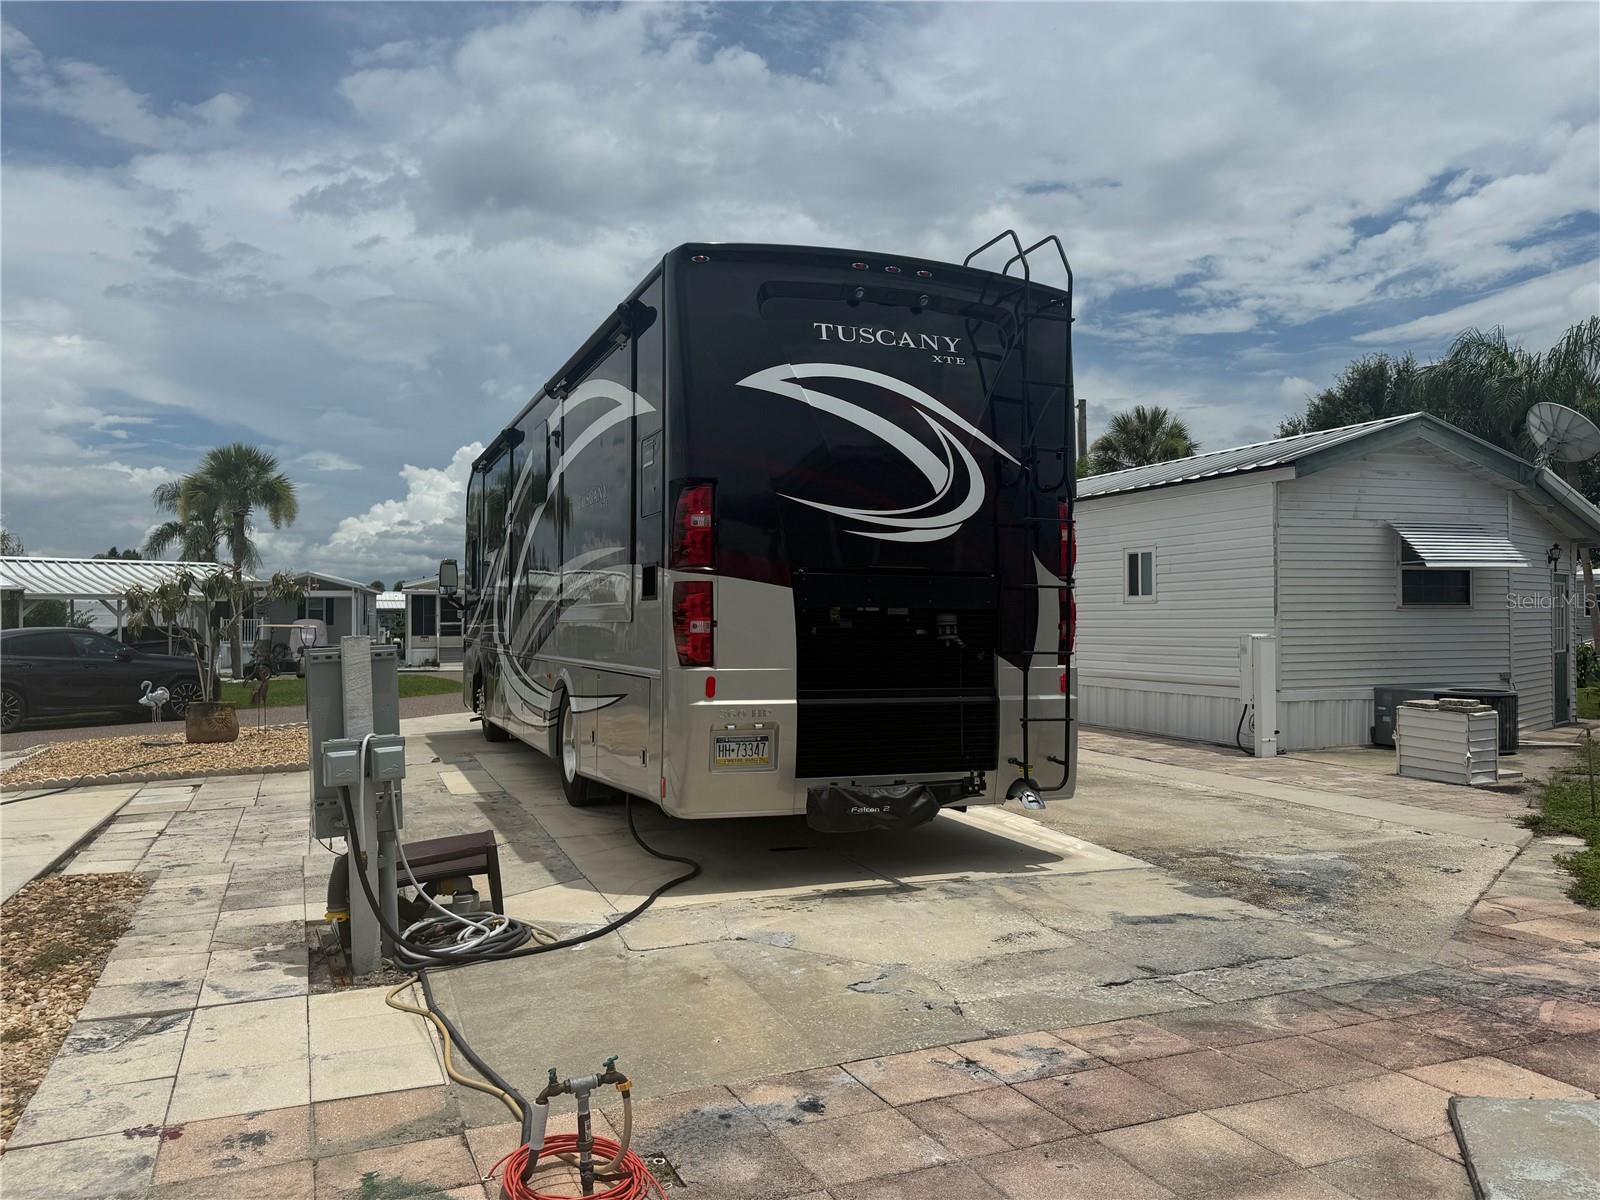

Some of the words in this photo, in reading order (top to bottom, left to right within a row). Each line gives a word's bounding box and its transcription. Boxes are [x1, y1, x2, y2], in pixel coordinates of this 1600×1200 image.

[813, 322, 961, 353] TUSCANY
[932, 355, 966, 365] XTE
[851, 806, 880, 814] Falcon
